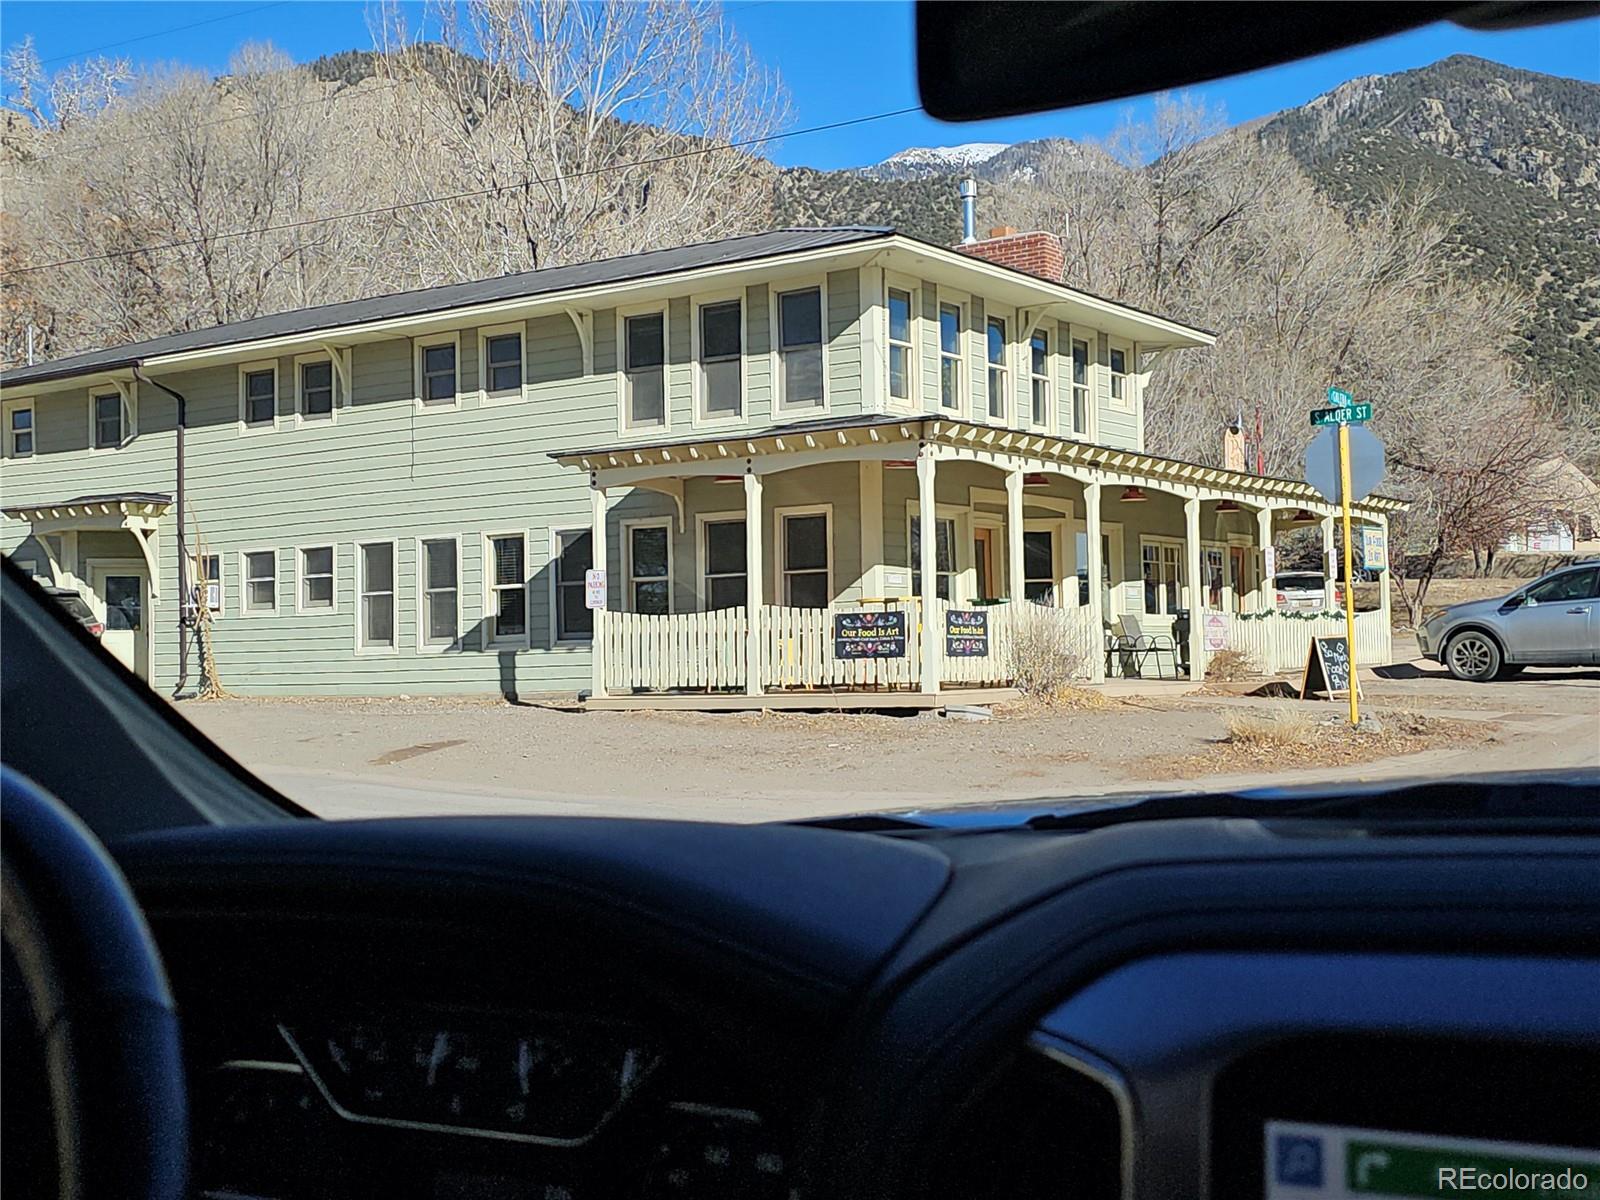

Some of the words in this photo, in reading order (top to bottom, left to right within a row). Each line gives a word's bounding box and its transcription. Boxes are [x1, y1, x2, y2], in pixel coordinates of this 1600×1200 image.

[1356, 406, 1367, 419] ST
[841, 628, 857, 637] Our
[858, 627, 877, 637] Food
[878, 627, 885, 636] Is
[886, 627, 900, 636] Art
